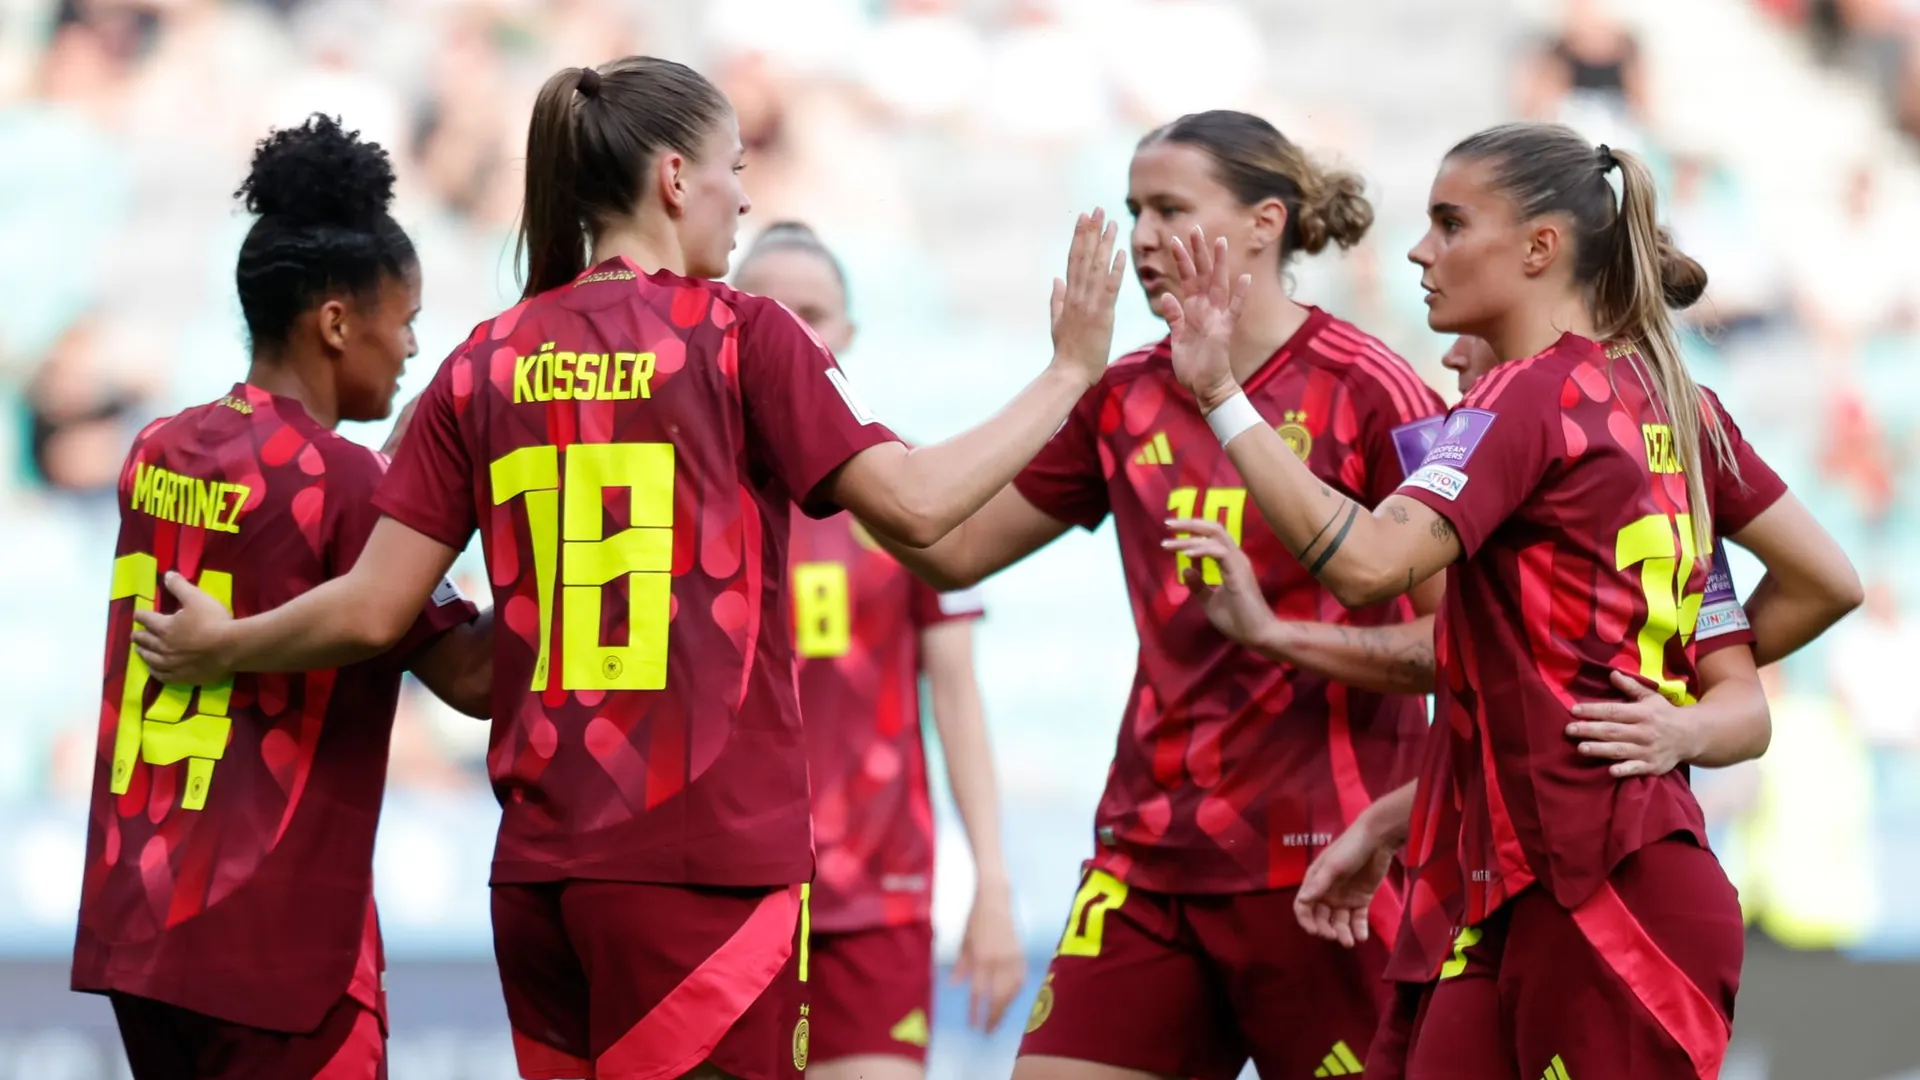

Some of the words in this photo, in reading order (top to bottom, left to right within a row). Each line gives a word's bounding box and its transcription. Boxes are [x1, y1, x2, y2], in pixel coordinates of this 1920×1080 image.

[513, 342, 656, 404] KÖSSLER
[132, 462, 251, 534] MARTINEZ
[490, 443, 675, 692] 18
[793, 561, 850, 658] 8
[109, 552, 234, 811] 14
